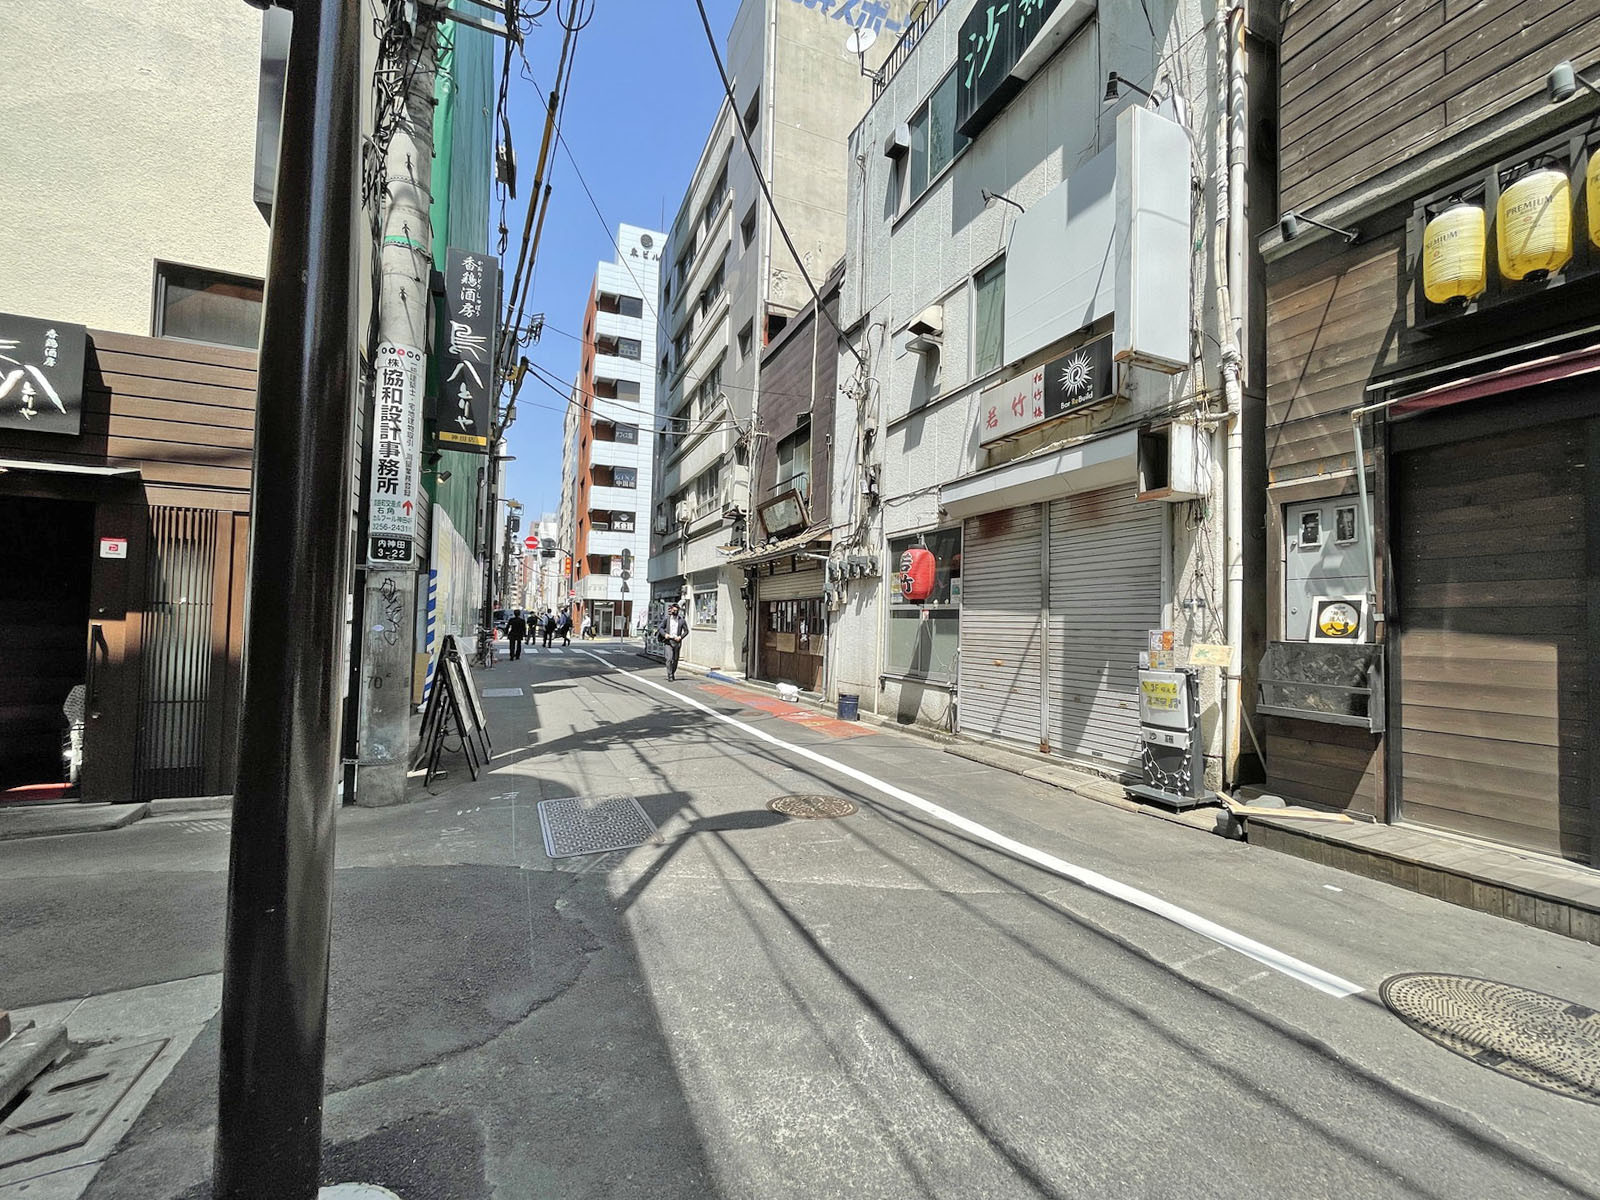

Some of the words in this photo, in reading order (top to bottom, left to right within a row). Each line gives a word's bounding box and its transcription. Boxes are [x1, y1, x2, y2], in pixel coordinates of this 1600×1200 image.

[1505, 194, 1553, 218] PREMIUM
[377, 539, 406, 549] 内神田
[377, 548, 405, 558] 3-22
